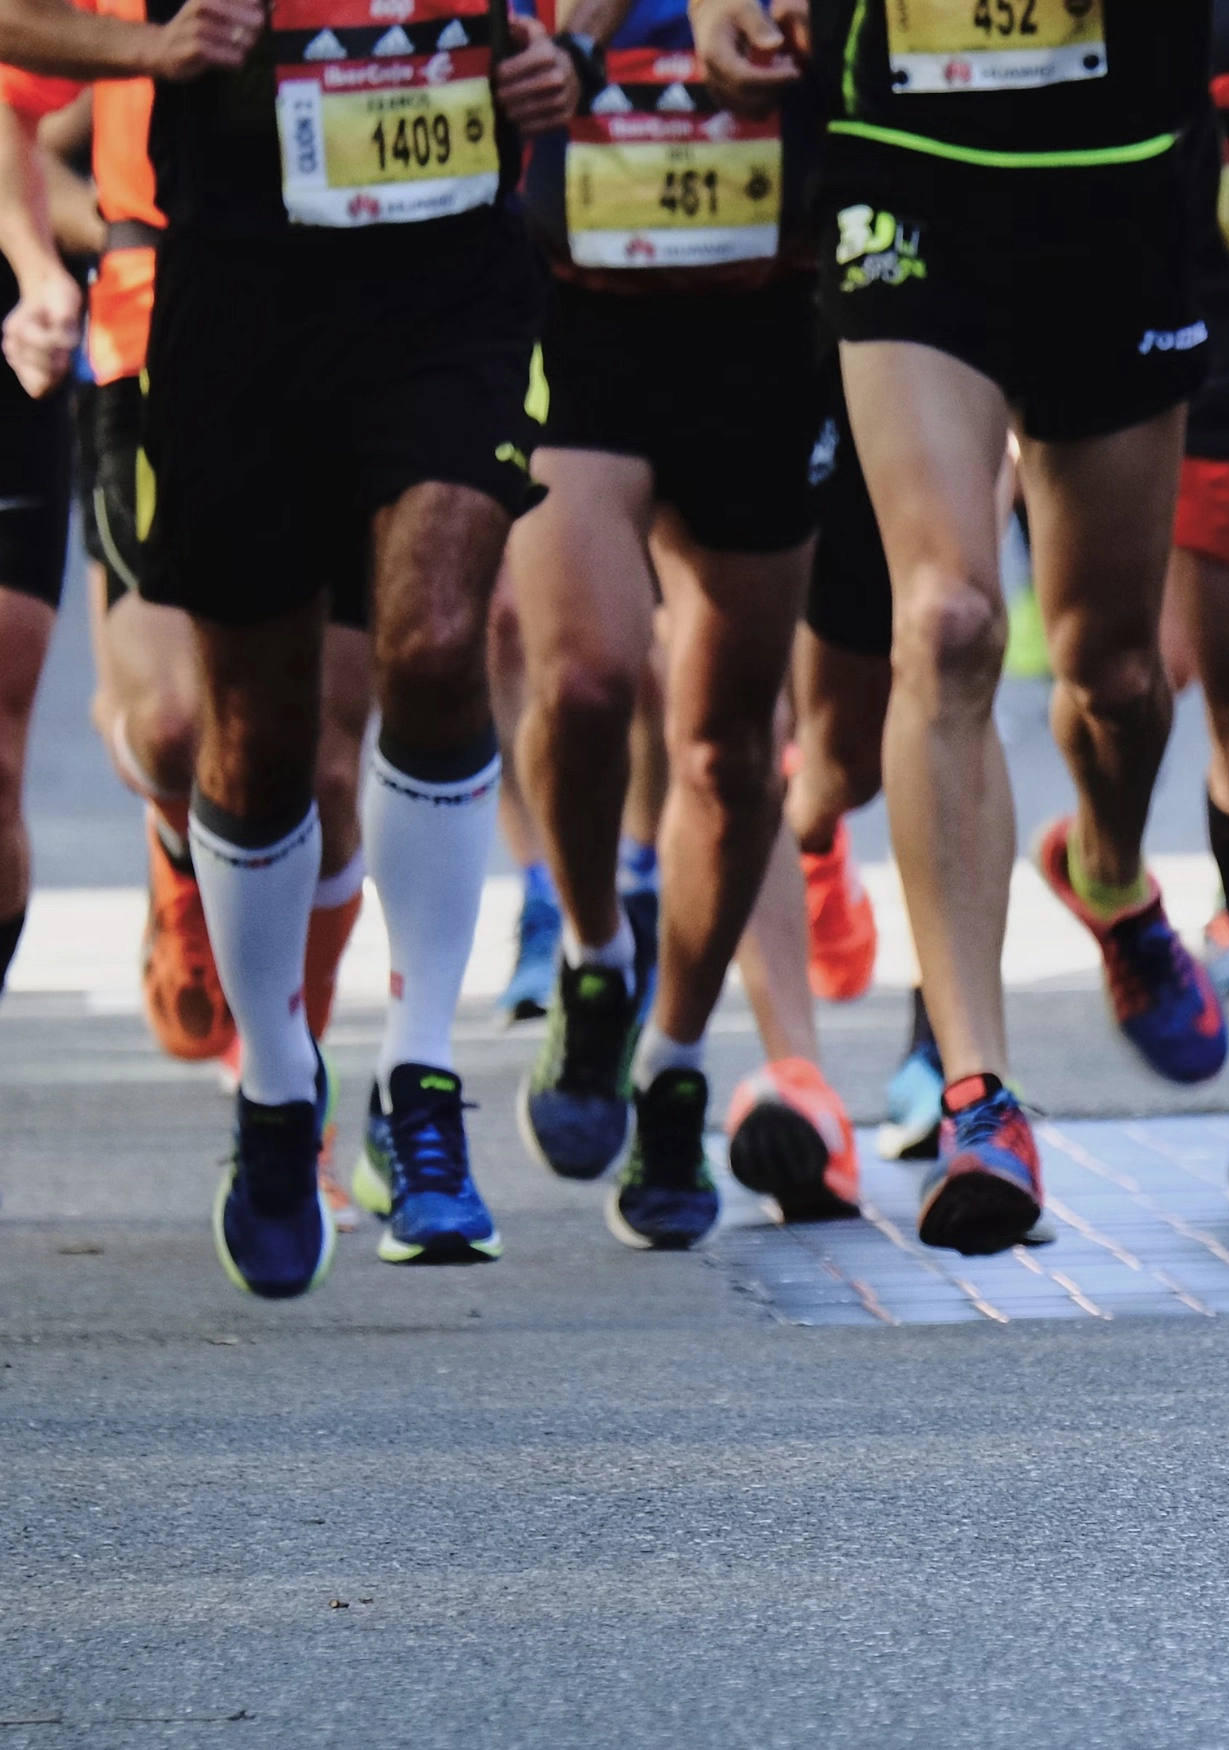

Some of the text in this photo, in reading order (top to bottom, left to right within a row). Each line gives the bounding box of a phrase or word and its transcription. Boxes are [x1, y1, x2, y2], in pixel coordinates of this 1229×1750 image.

[973, 0, 1038, 36] 452
[373, 113, 451, 171] 1409
[660, 170, 718, 217] 461
